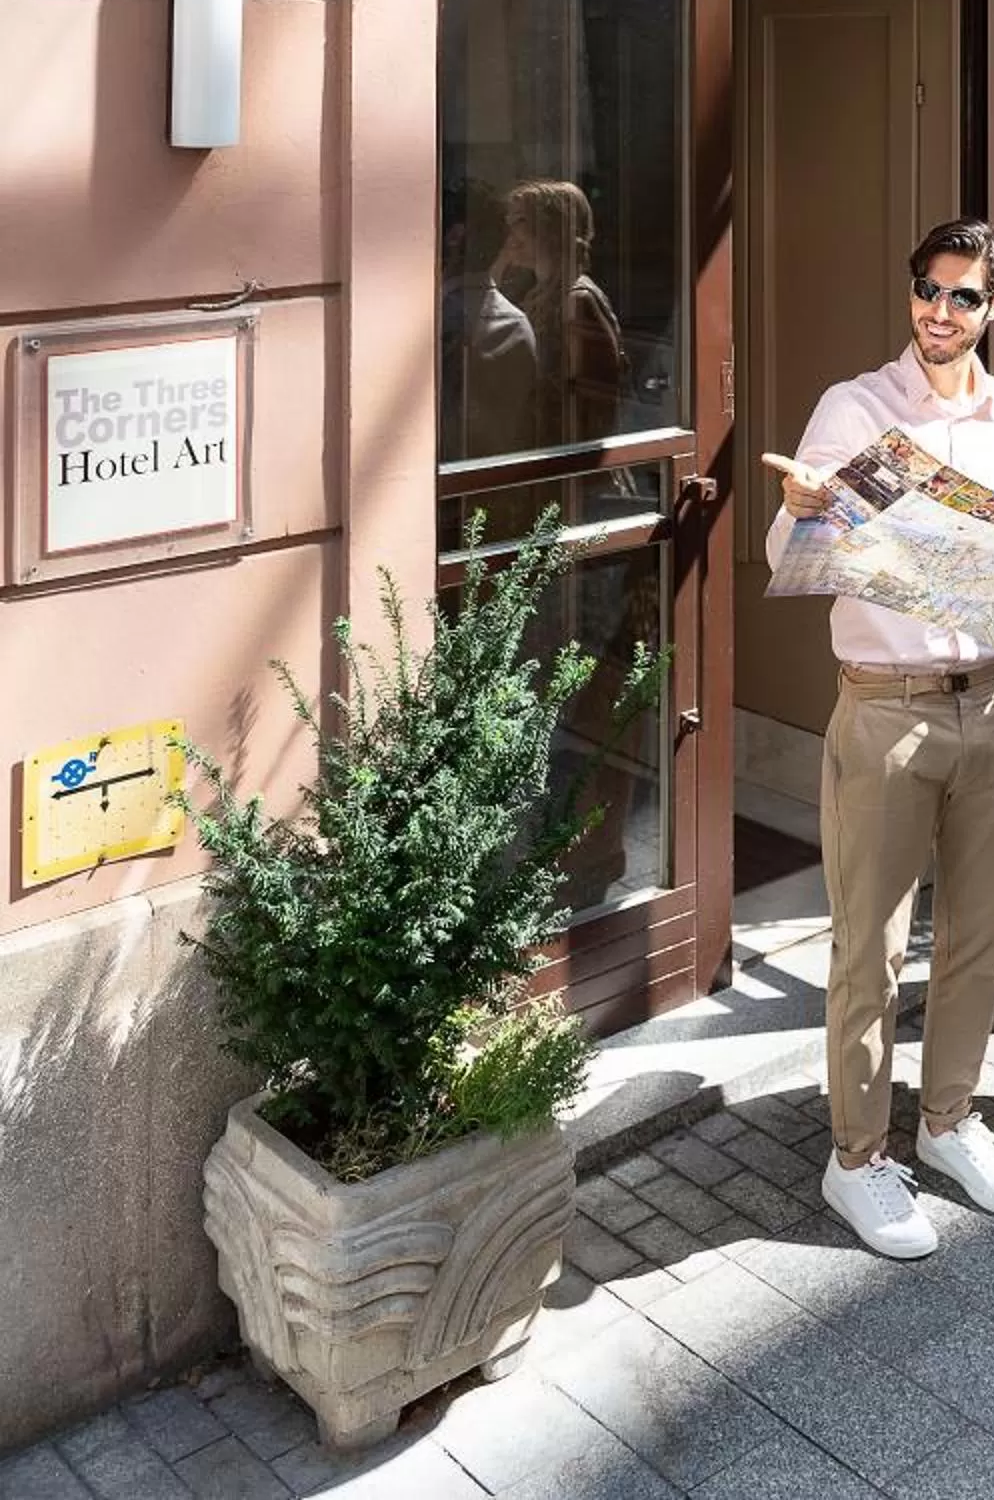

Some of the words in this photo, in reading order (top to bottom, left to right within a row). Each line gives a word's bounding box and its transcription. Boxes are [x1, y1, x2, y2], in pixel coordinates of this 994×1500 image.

[55, 387, 122, 414] The
[133, 376, 228, 408] Three
[55, 401, 228, 449] Corners
[58, 440, 160, 487] Hotel
[172, 436, 228, 469] Art
